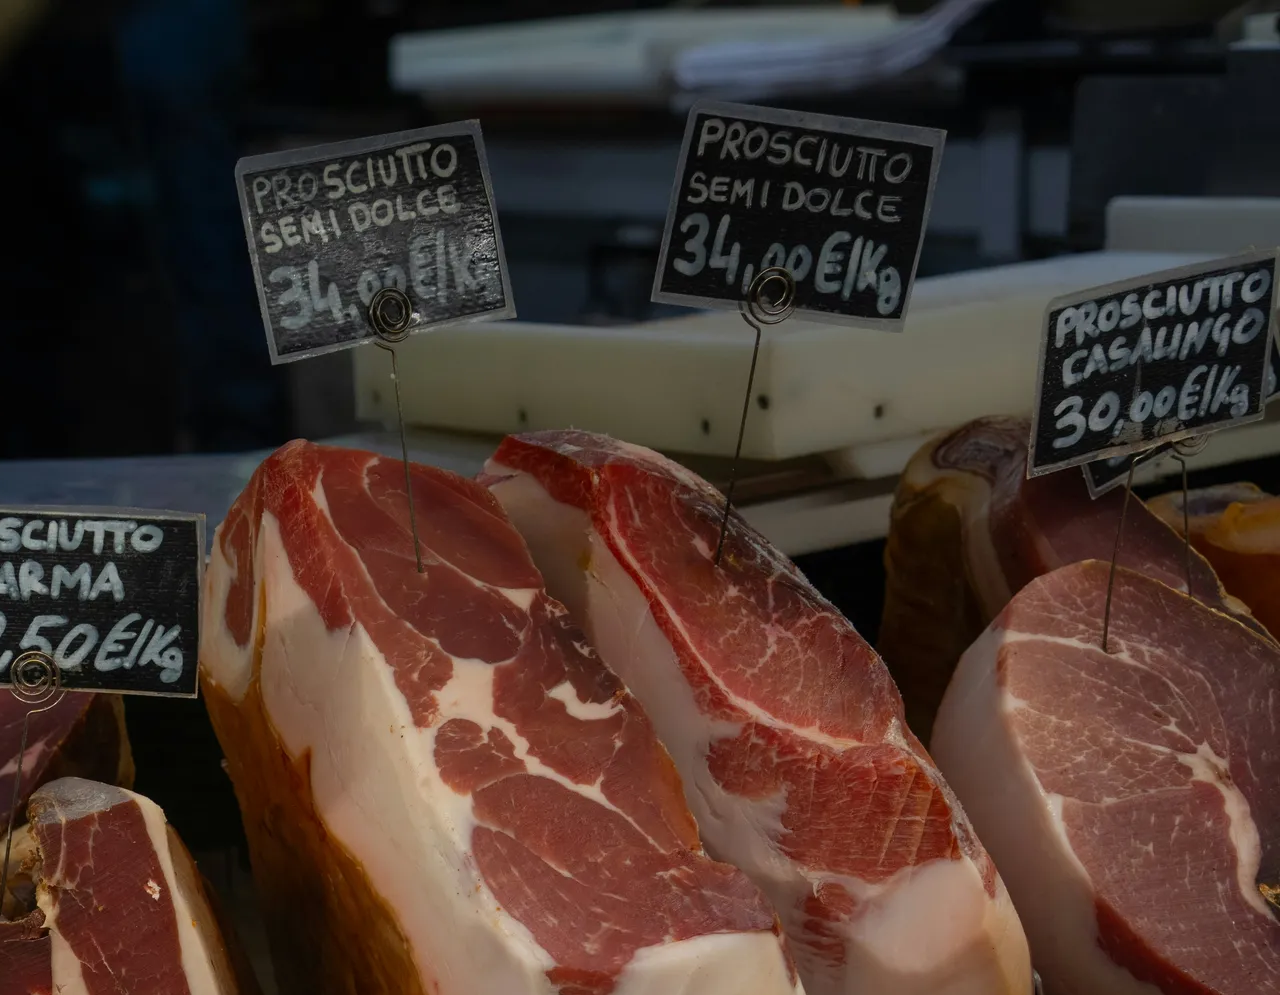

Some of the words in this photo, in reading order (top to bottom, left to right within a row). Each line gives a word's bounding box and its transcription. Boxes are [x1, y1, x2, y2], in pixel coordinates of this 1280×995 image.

[252, 142, 458, 215] PROSCIUTTO
[697, 118, 913, 184] PROSCIUTTO
[348, 184, 461, 233] DOLCE
[687, 171, 770, 209] SEMI
[782, 181, 902, 223] DOLCE
[1055, 268, 1271, 348] PROSCIUTTO
[1062, 307, 1266, 389] CASALINGO
